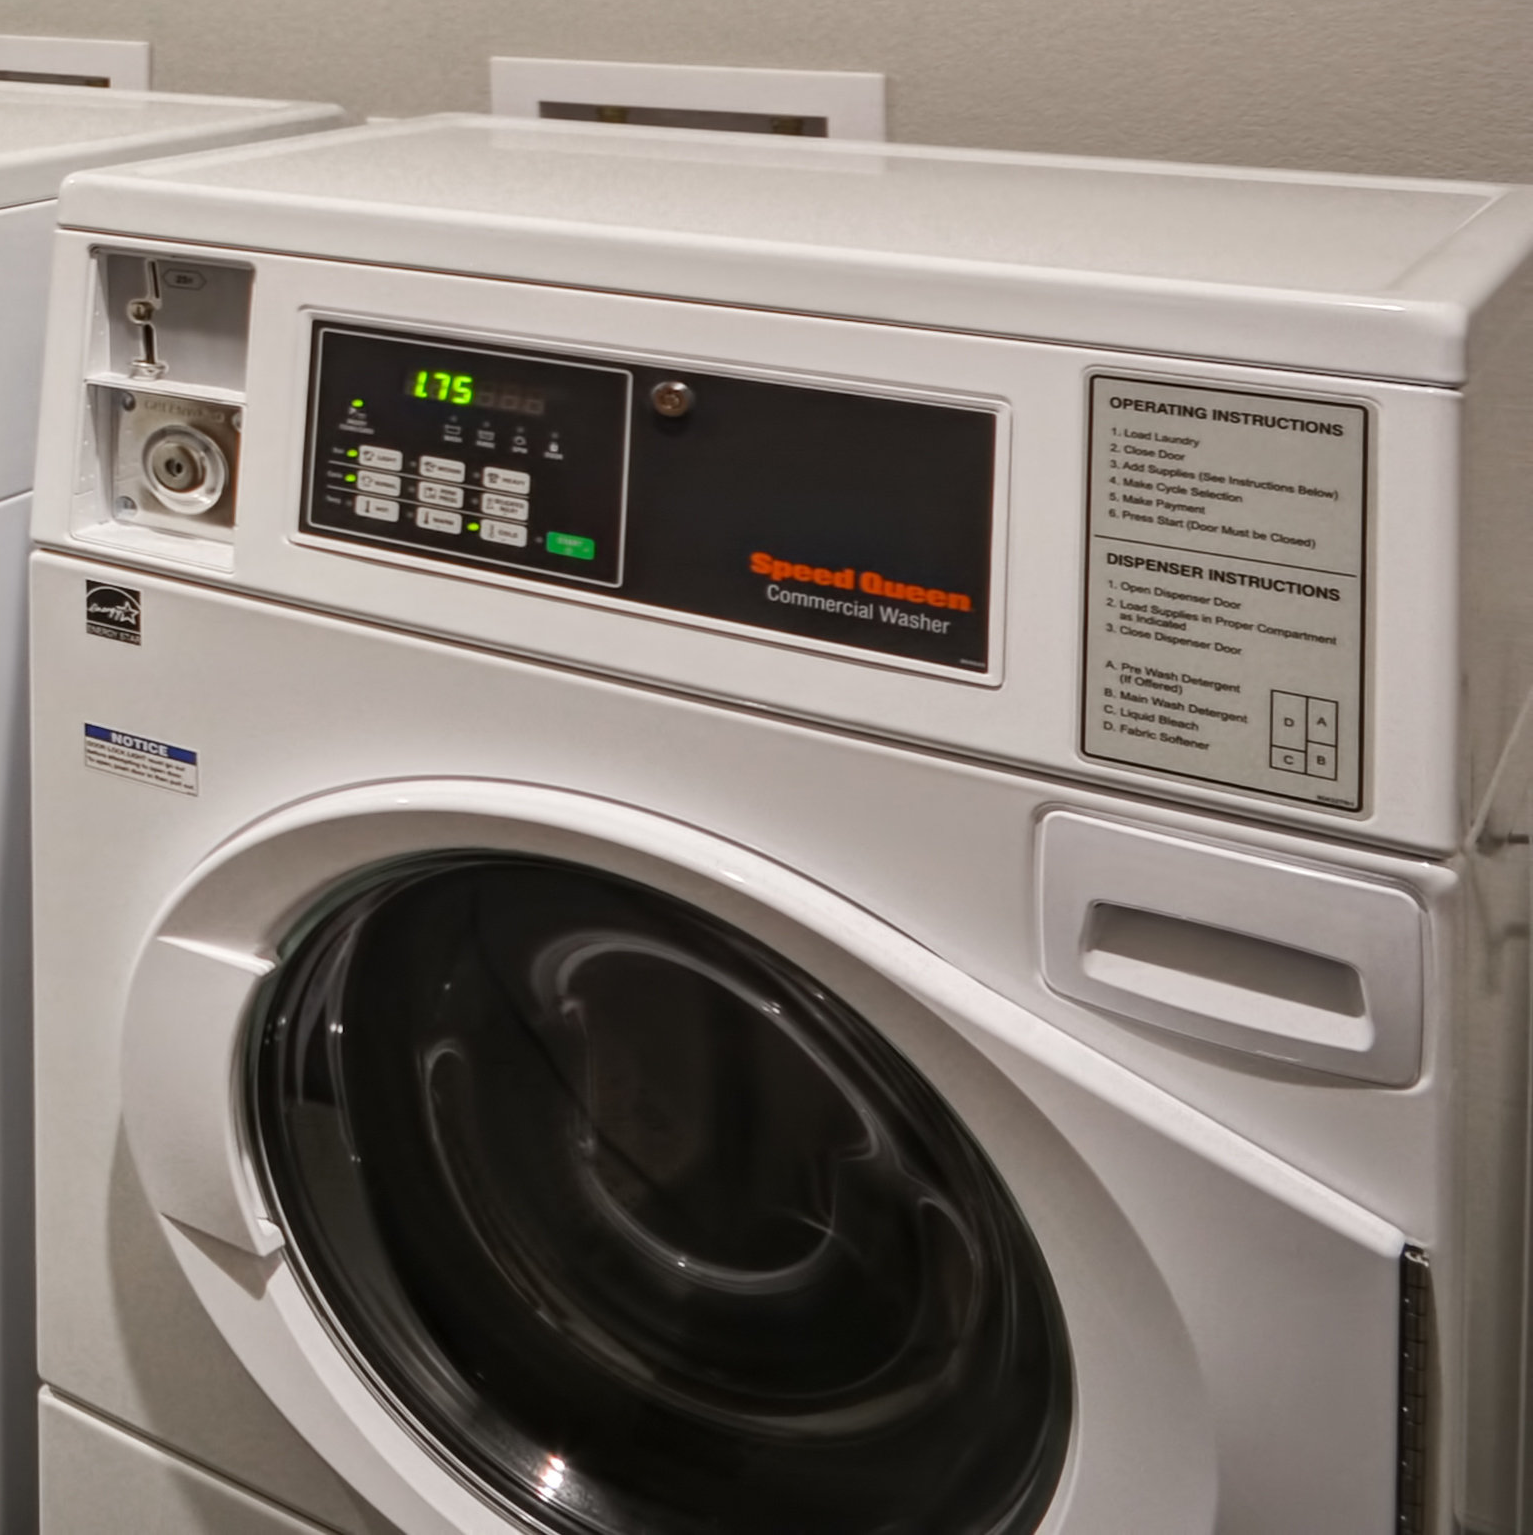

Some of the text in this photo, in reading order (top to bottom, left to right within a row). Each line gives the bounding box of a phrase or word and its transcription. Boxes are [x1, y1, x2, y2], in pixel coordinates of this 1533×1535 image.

[1109, 397, 1344, 437] OPERATING INSTRUCTIONS
[1110, 443, 1185, 461] 2. Close Door
[1112, 427, 1200, 448] 1. Load Laundry
[1109, 476, 1243, 503] 4. Make Cycle Selection
[1110, 460, 1339, 501] 3. Add Supplies (See Instructions Below)
[1109, 492, 1205, 515] 5. Make Payment
[1109, 508, 1316, 549] 6. Press Start (Door Must be Closed)
[749, 551, 973, 613] Speed Queen
[1107, 553, 1341, 602] DISPENSER INSTRUCTIONS
[766, 584, 951, 634] Commercial Washer
[1108, 579, 1241, 610] 1. Open Dispenser Door
[1106, 597, 1337, 646] 2. Load Supplies in Proper Compartment
[1119, 612, 1186, 631] as Indicated
[1106, 623, 1242, 655] 3. Close Dispenser Door
[1105, 660, 1241, 694] A. Pre Wash Detergent
[1119, 674, 1183, 695] (If Offered)
[1104, 688, 1248, 724] B. Main Wash Detergent
[1104, 704, 1199, 731] C. Liquid Bleach
[1103, 720, 1209, 751] D. Fabric Softener
[1284, 717, 1295, 728] D
[1316, 716, 1327, 727] A
[111, 732, 169, 756] NOTICE
[1284, 755, 1294, 765] C
[1316, 755, 1326, 766] B
